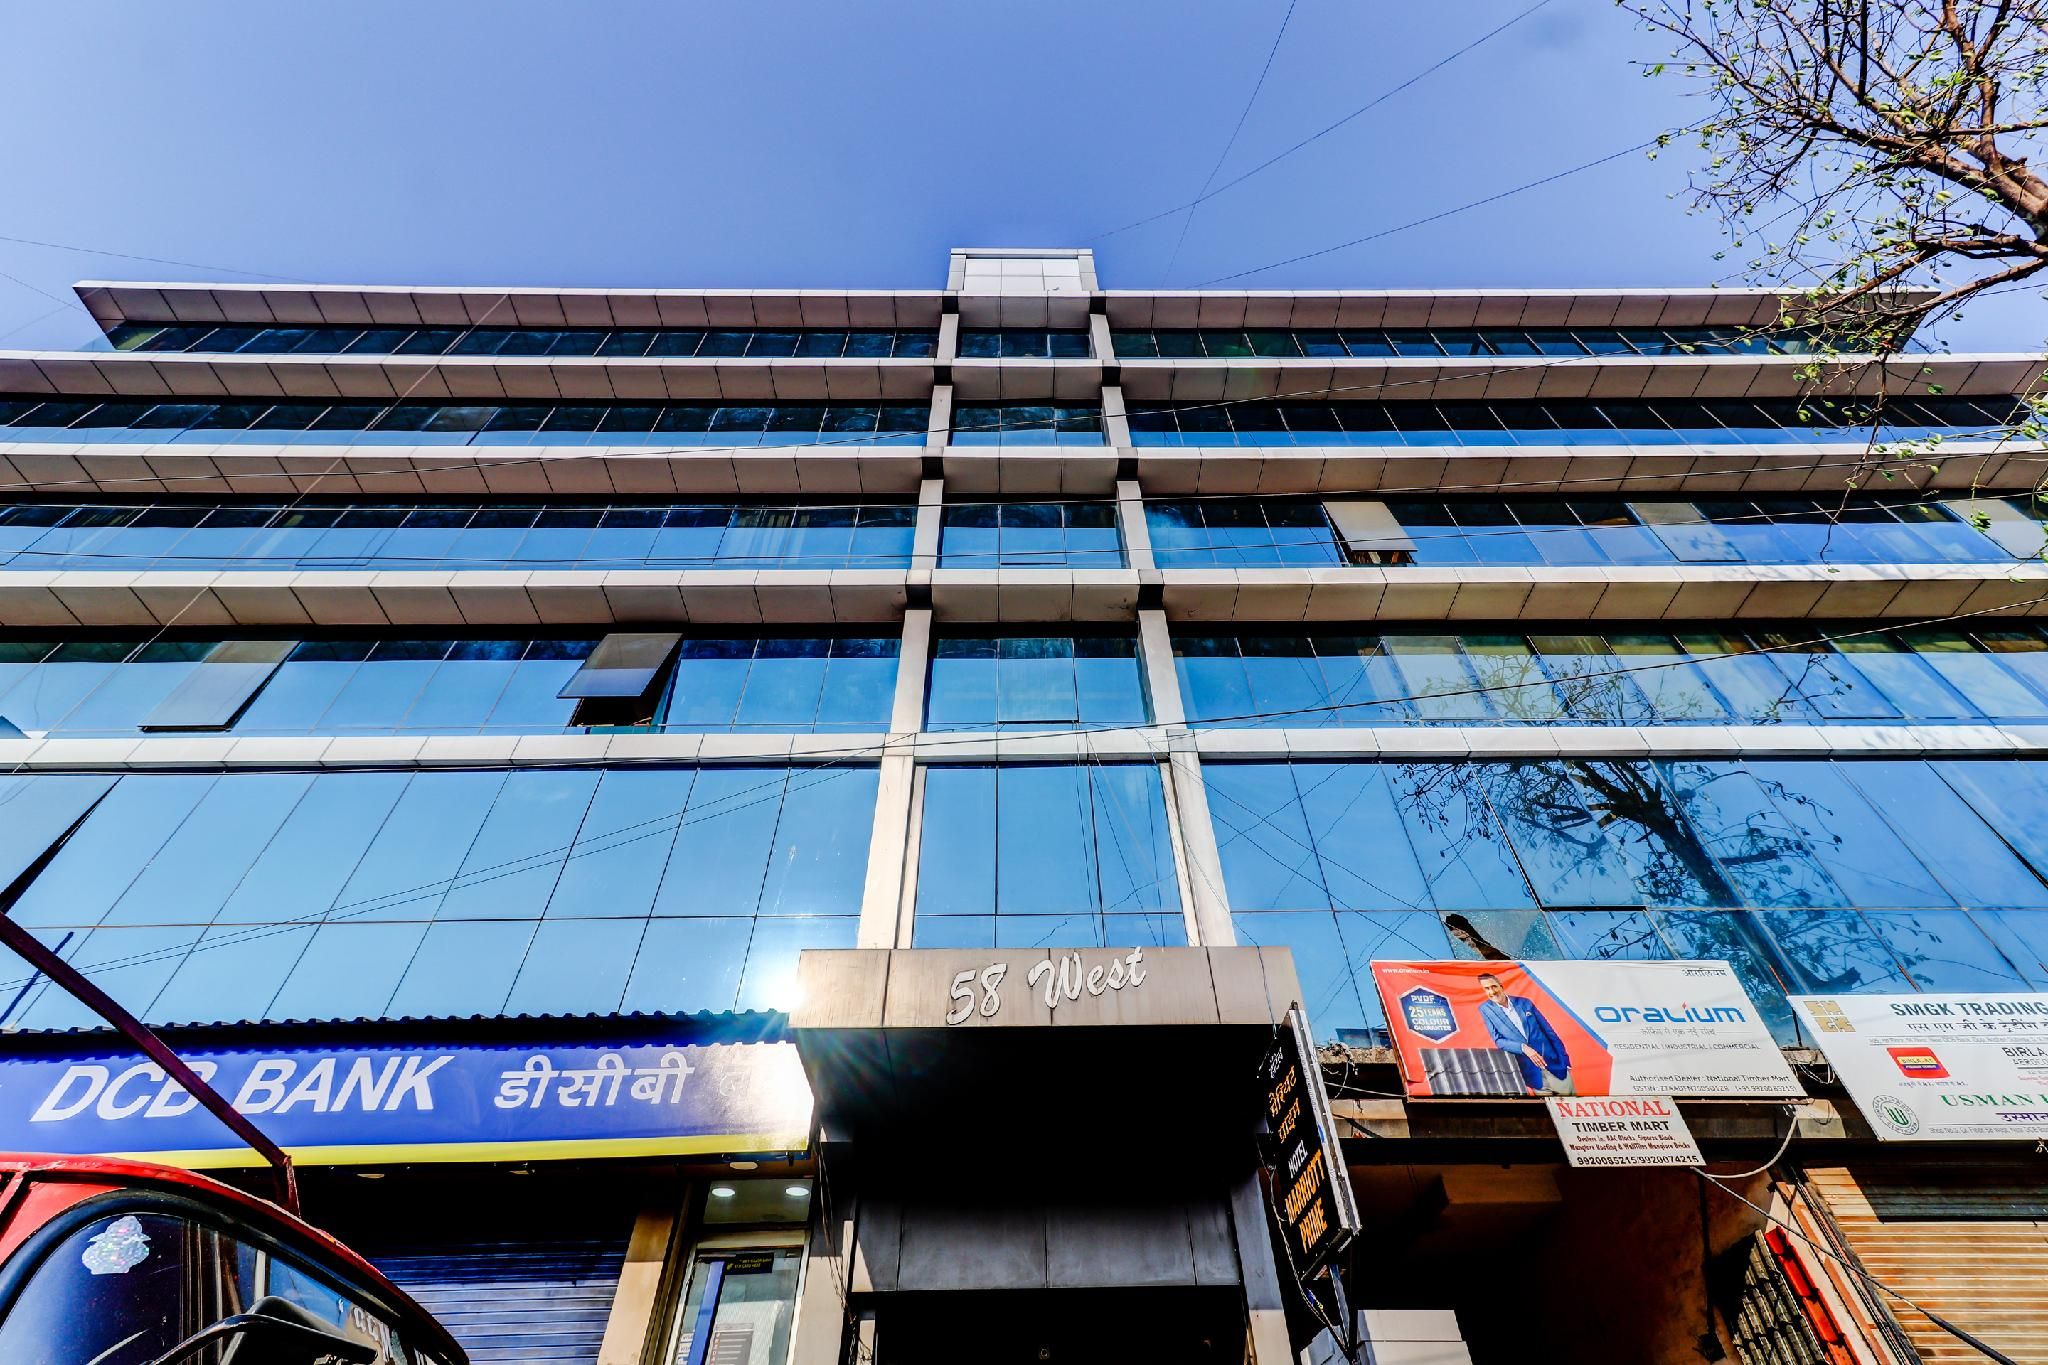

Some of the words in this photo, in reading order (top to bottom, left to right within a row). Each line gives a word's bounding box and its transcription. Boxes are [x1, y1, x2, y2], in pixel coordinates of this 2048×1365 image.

[946, 963, 1008, 1026] 58
[1027, 946, 1147, 1009] West
[1408, 1006, 1424, 1018] 25
[1889, 1002, 1954, 1016] SMGK
[231, 1055, 455, 1115] BANK
[494, 1052, 695, 1109] डीसीबी
[1939, 1094, 2036, 1106] USMAN
[1556, 1100, 1671, 1118] NATIONAL
[1572, 1121, 1628, 1133] TIMBER
[1630, 1120, 1671, 1132] MART
[1287, 1139, 1309, 1180] HOTEL
[1284, 1148, 1325, 1228] MARRIOTT
[1298, 1197, 1328, 1255] PRIME
